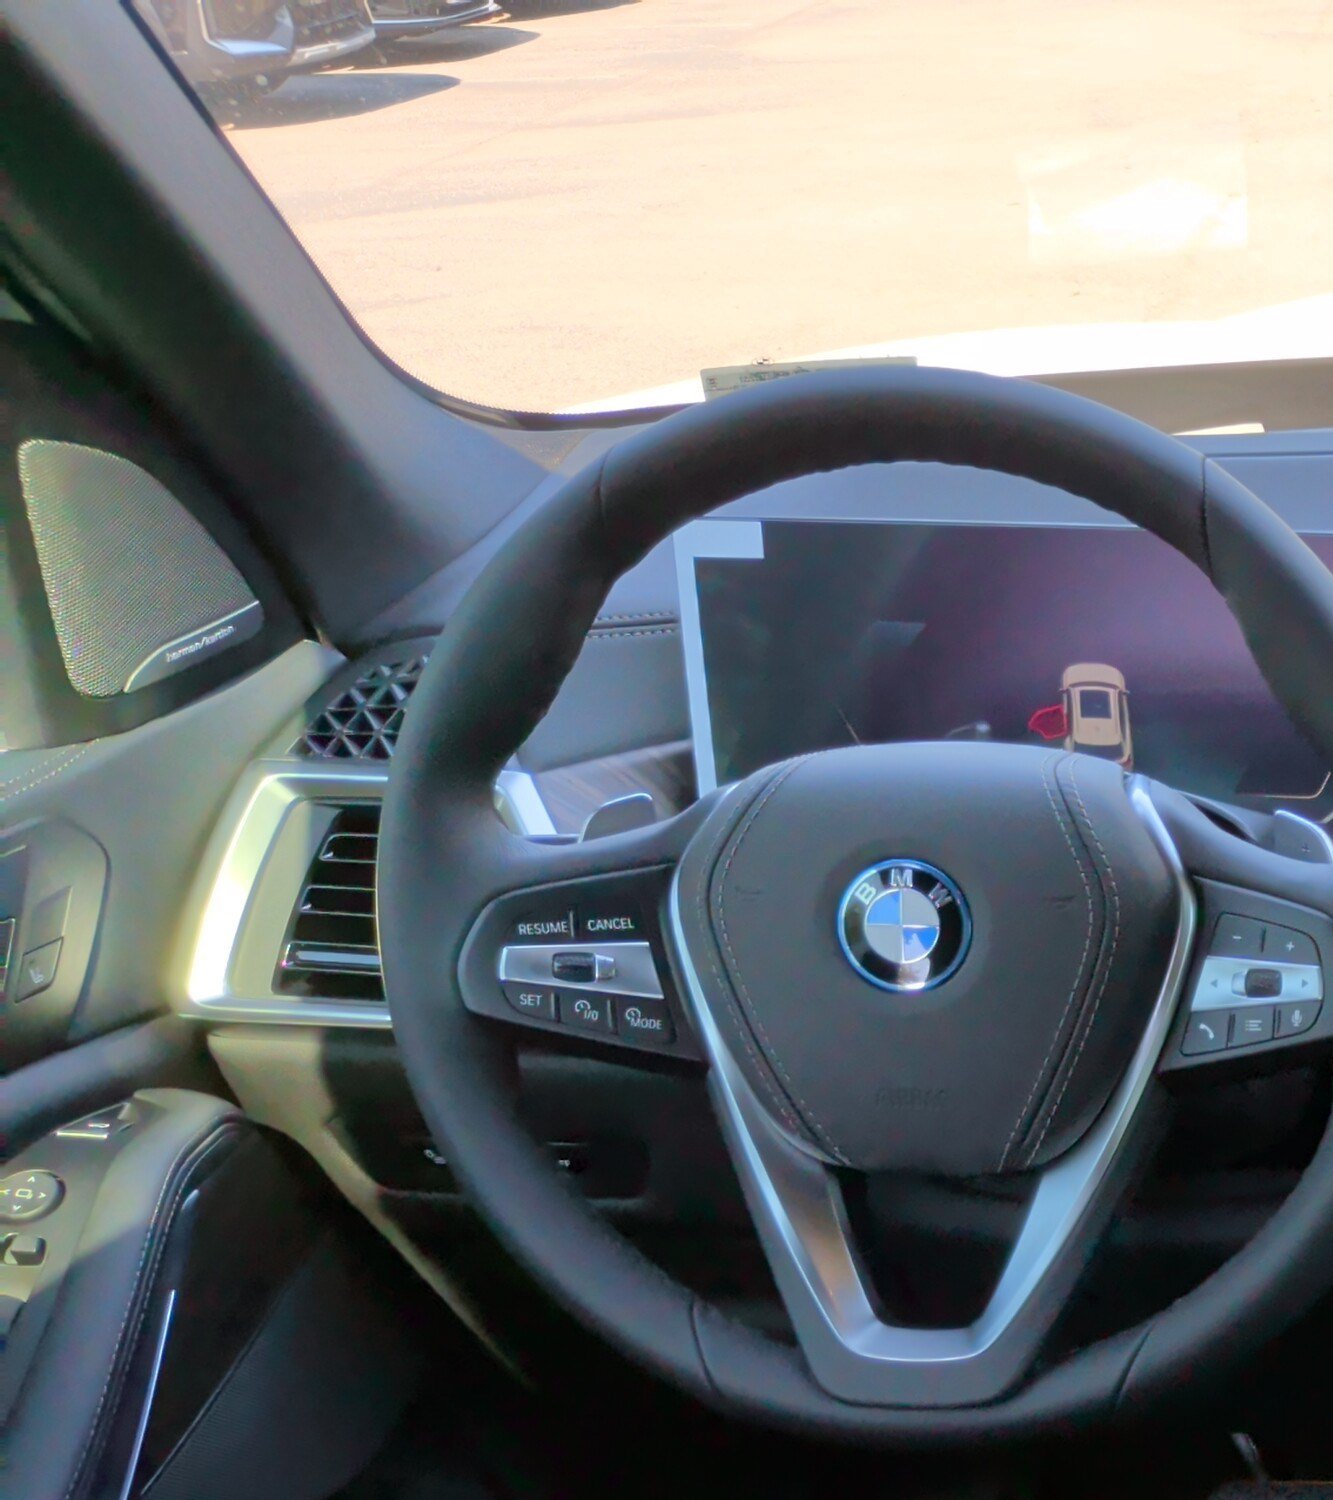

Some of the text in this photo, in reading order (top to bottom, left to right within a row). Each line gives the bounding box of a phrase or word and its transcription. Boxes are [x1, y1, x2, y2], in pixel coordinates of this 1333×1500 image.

[854, 867, 953, 909] BMW
[518, 921, 568, 936] RESUME
[587, 917, 635, 932] CANCEL
[519, 993, 543, 1006] SET
[629, 1015, 663, 1031] MODE
